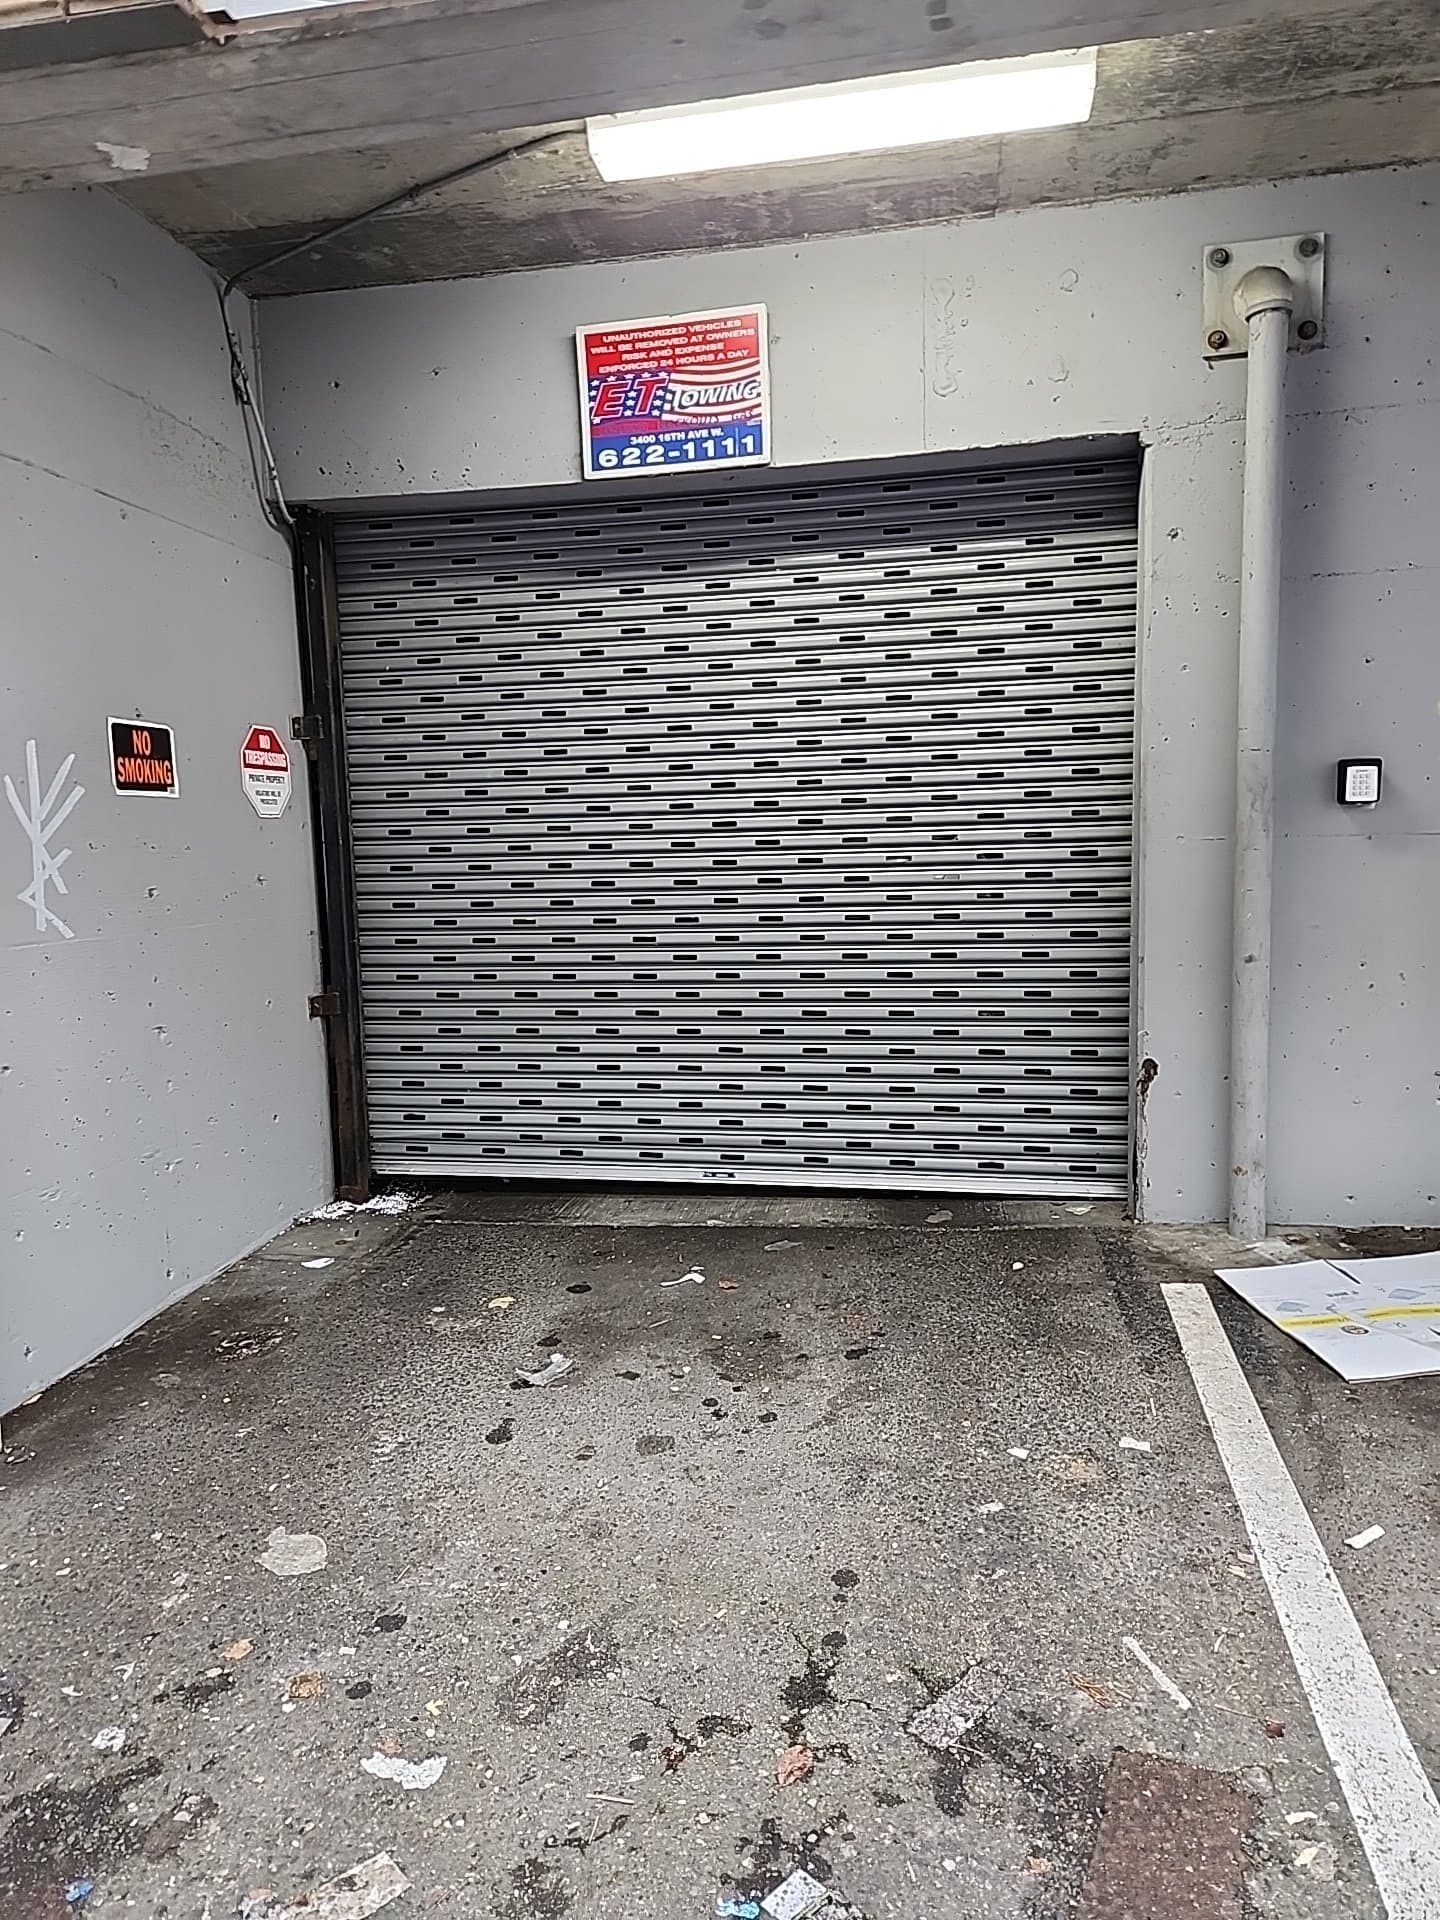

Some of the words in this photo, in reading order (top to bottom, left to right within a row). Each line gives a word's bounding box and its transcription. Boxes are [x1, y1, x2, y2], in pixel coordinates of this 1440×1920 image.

[591, 345, 616, 355] WILL
[618, 342, 634, 352] BE
[637, 336, 688, 350] REMOVED
[690, 334, 704, 343] AT
[706, 328, 755, 341] OWNERS
[602, 326, 687, 343] UNAUTHORIZED
[688, 319, 742, 334] VEHICLES
[599, 361, 658, 374] ENFORCED
[659, 358, 674, 367] 24
[675, 353, 715, 365] HOURS
[716, 351, 726, 361] A
[727, 349, 750, 359] DAY
[621, 350, 648, 361] RISK
[649, 347, 674, 358] AND
[674, 342, 725, 356] EXPENSE
[630, 434, 656, 445] 3400
[687, 429, 709, 440] AVE
[598, 435, 754, 468] 622-1111
[132, 729, 151, 756] NO
[258, 734, 271, 750] NO
[117, 756, 173, 785] SMOKING
